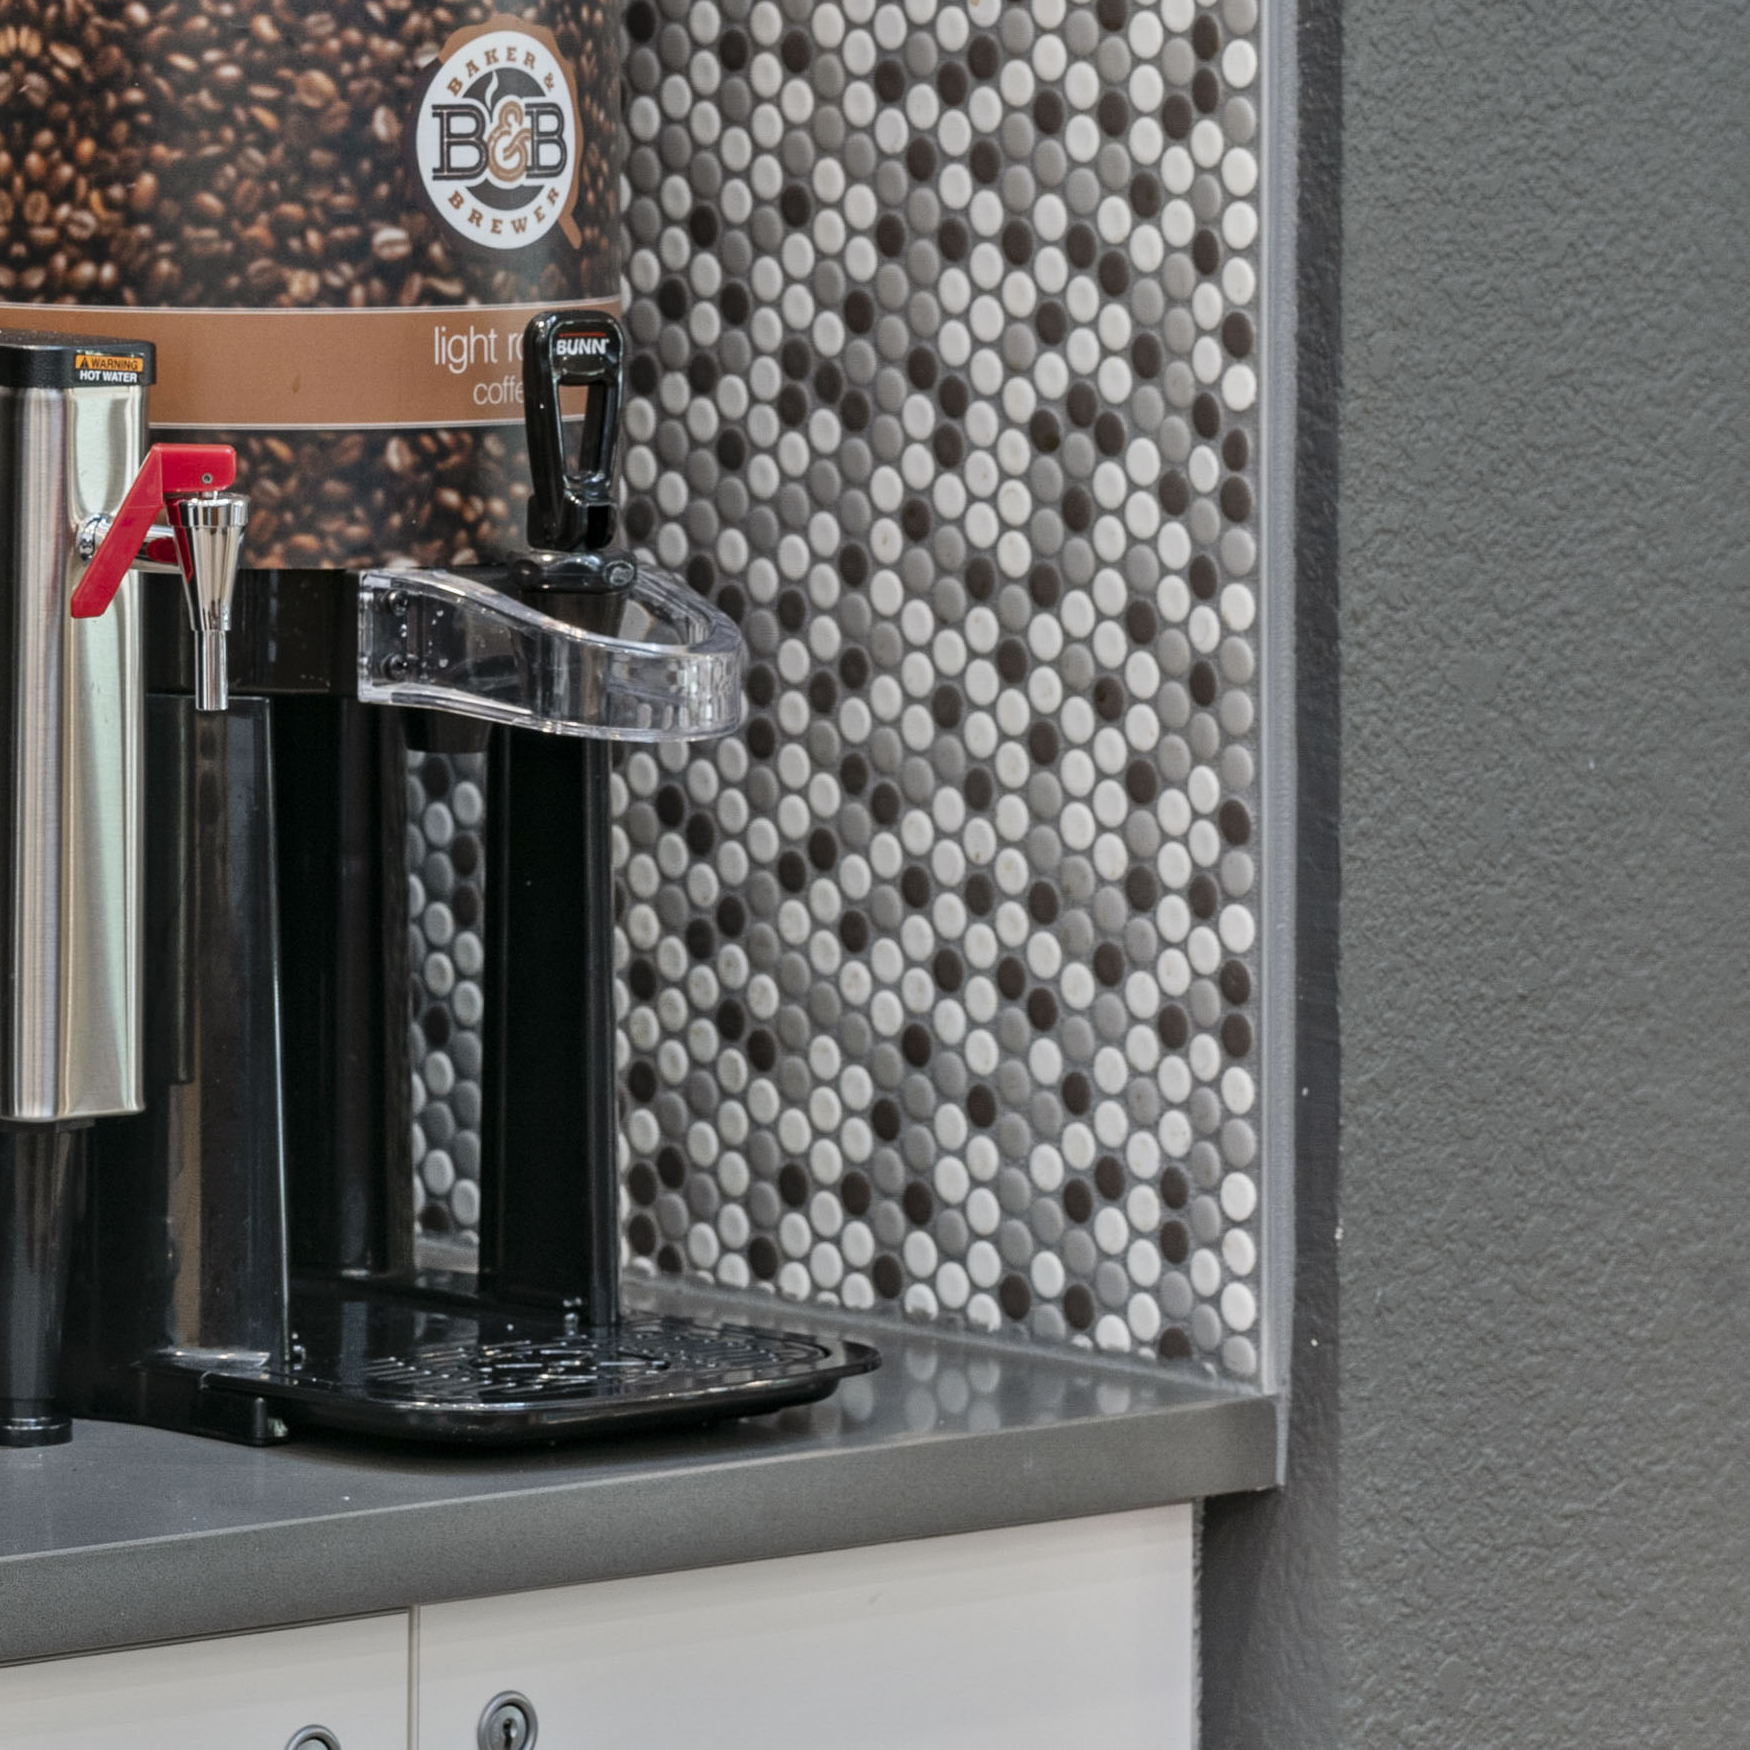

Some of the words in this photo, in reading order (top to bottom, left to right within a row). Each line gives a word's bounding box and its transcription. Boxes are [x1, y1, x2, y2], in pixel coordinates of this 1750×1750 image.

[445, 45, 538, 98] BAKER
[446, 185, 561, 238] BREWER
[90, 357, 139, 371] WARNING
[433, 324, 499, 375] light
[79, 369, 102, 382] HOT
[102, 371, 138, 384] WATER
